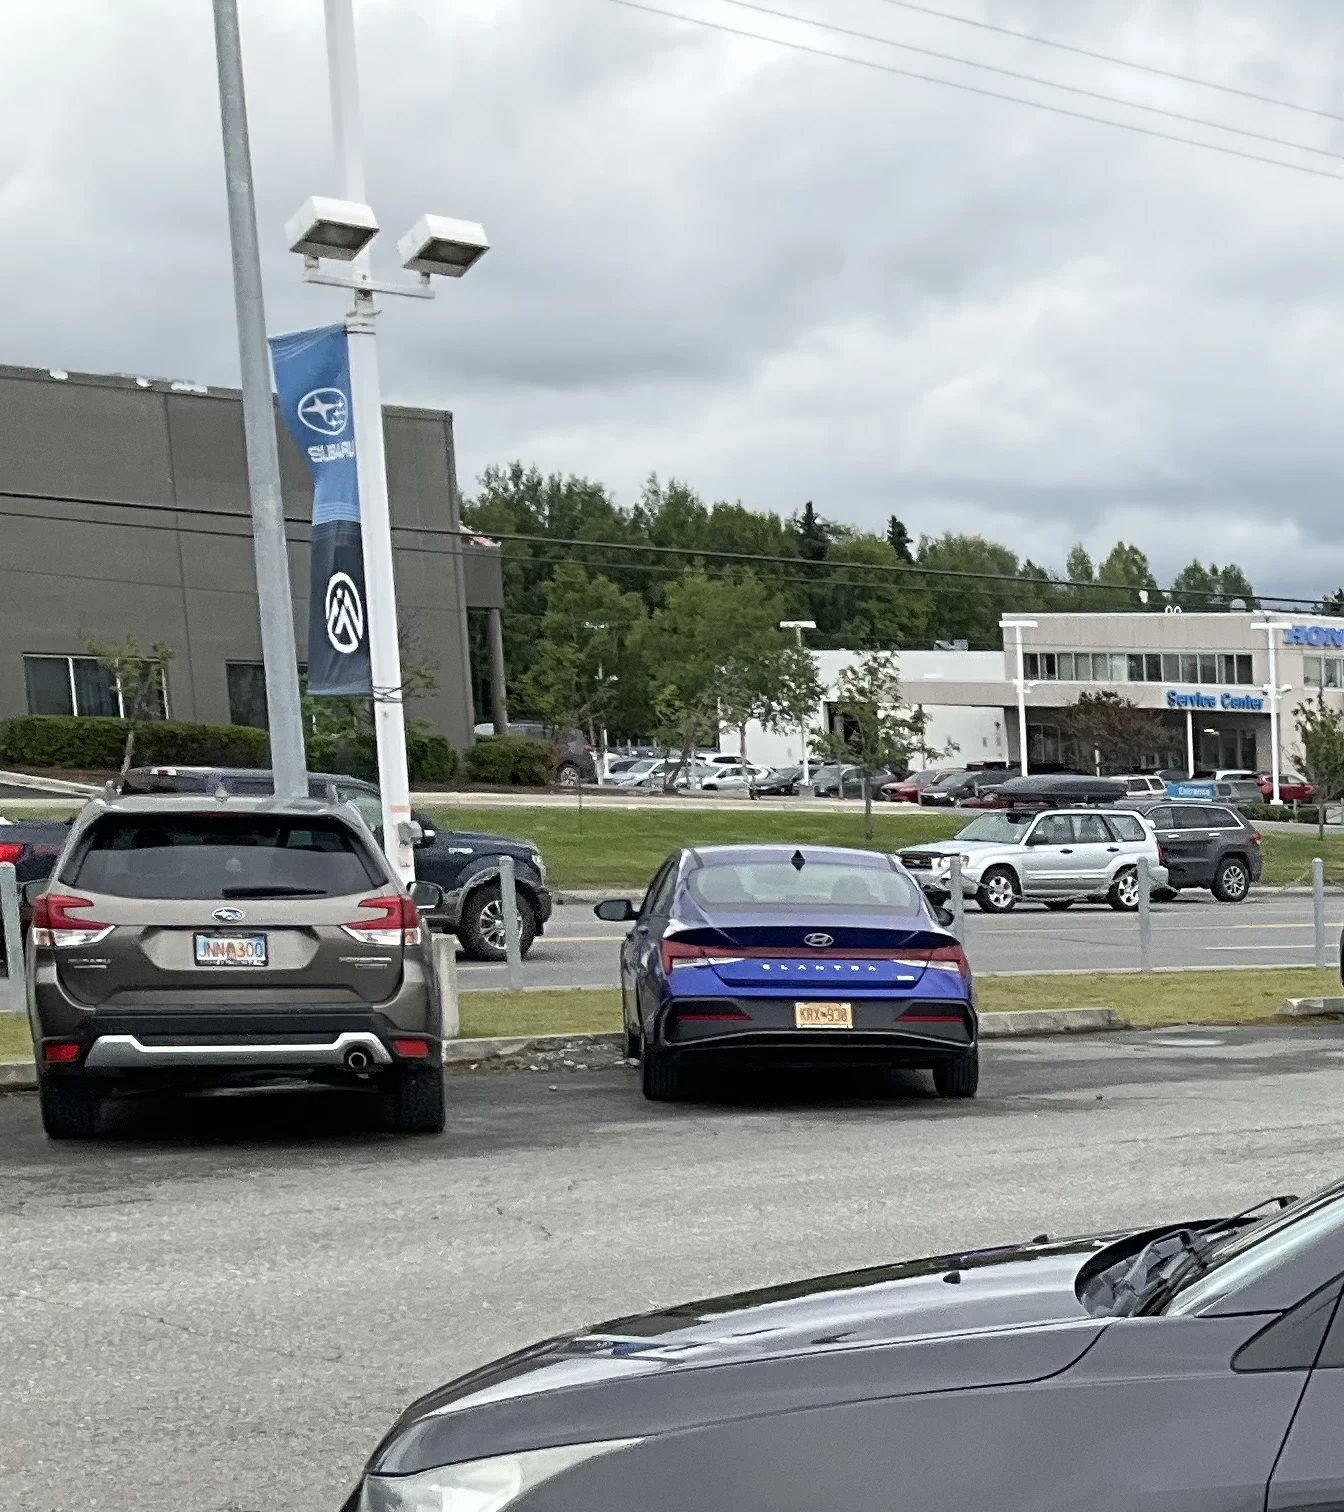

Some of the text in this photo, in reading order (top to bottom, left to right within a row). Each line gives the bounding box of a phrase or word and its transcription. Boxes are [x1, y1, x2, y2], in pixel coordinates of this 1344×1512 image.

[1167, 690, 1265, 711] Service Center
[762, 963, 877, 972] ELANTRA
